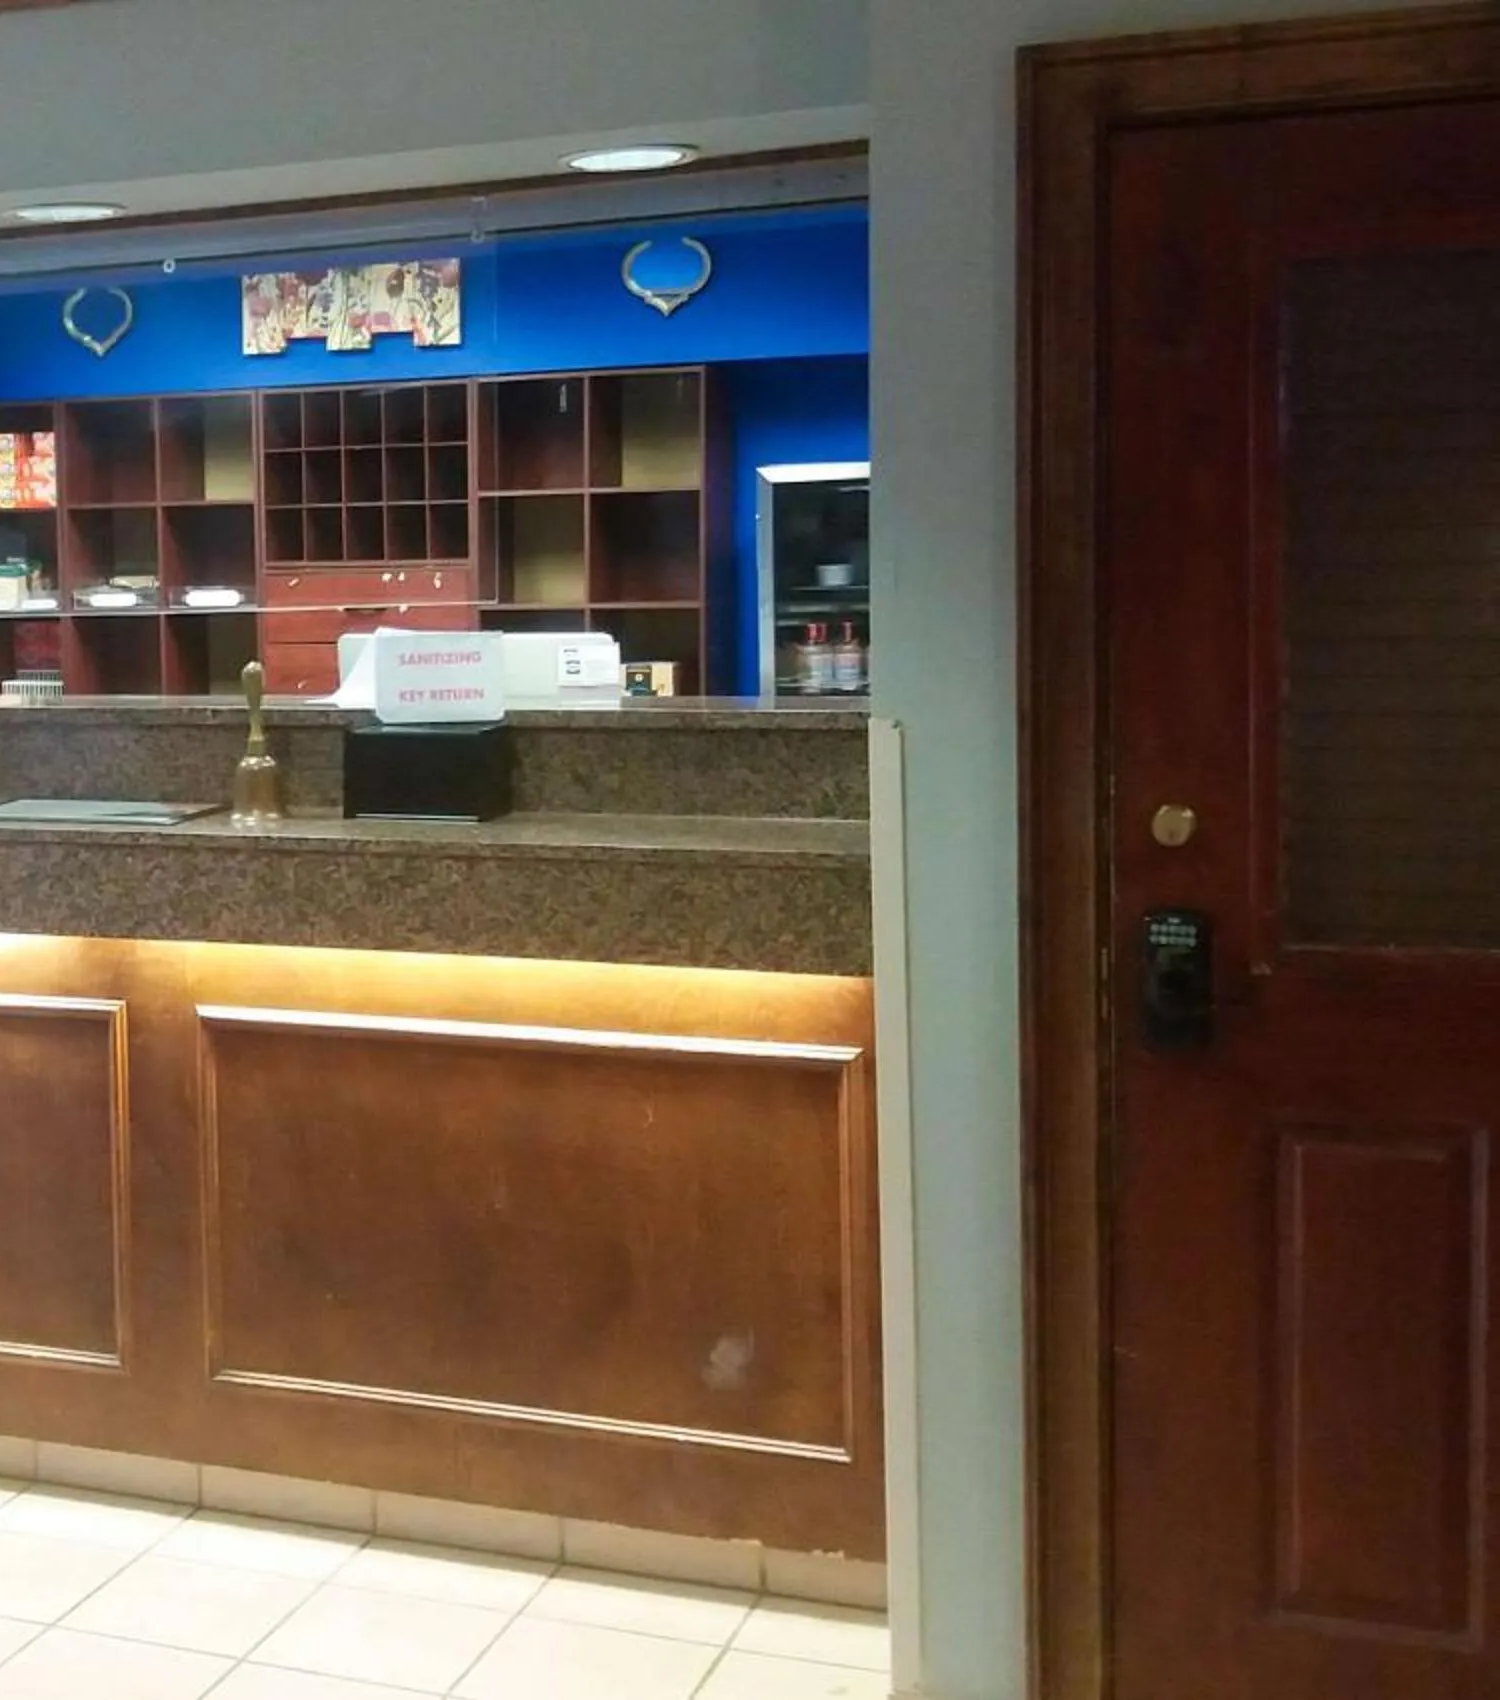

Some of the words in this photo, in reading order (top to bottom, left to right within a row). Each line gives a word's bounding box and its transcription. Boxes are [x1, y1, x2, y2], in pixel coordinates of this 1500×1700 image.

[398, 651, 482, 666] SANITIZING
[399, 689, 424, 702] KEY
[429, 687, 485, 701] RETURN
